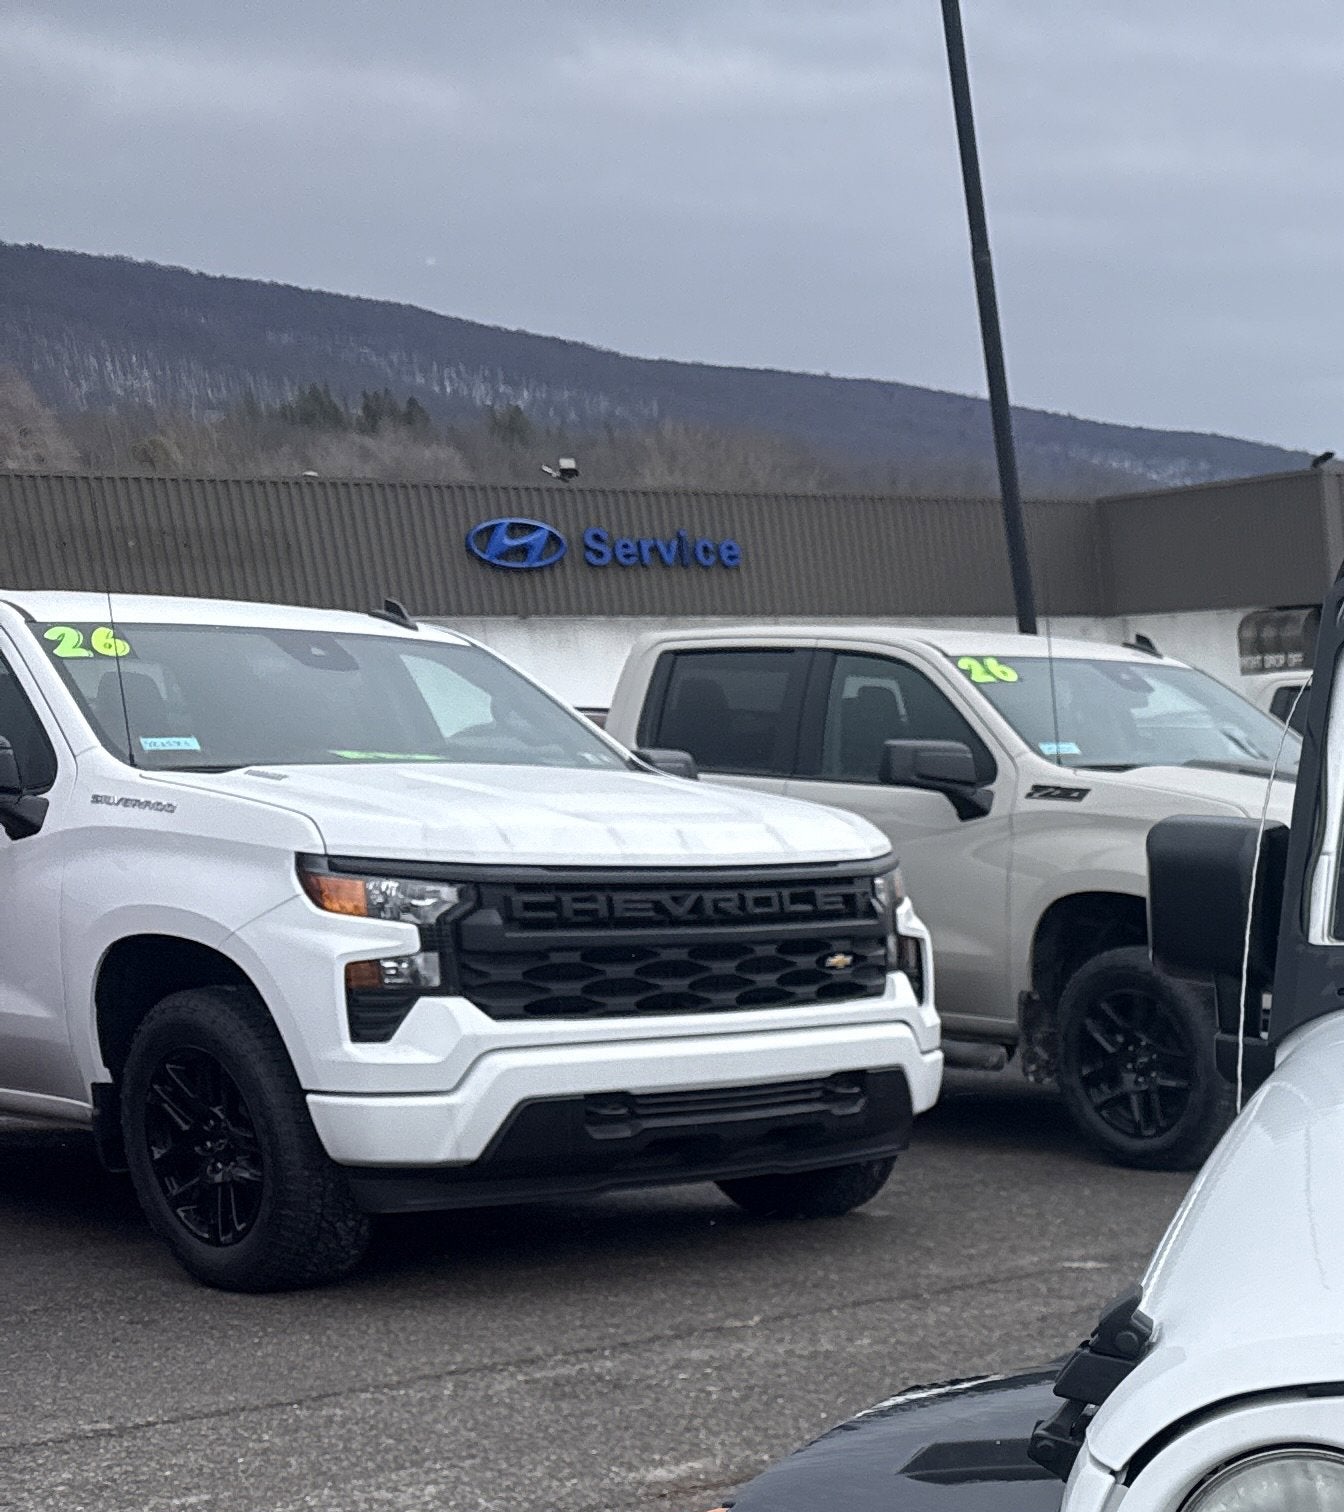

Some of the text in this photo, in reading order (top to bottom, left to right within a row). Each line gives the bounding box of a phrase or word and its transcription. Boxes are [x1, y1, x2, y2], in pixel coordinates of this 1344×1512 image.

[583, 526, 741, 568] Service
[43, 626, 130, 658] 26
[957, 657, 1018, 683] 26
[508, 885, 874, 923] CHEVROLET
